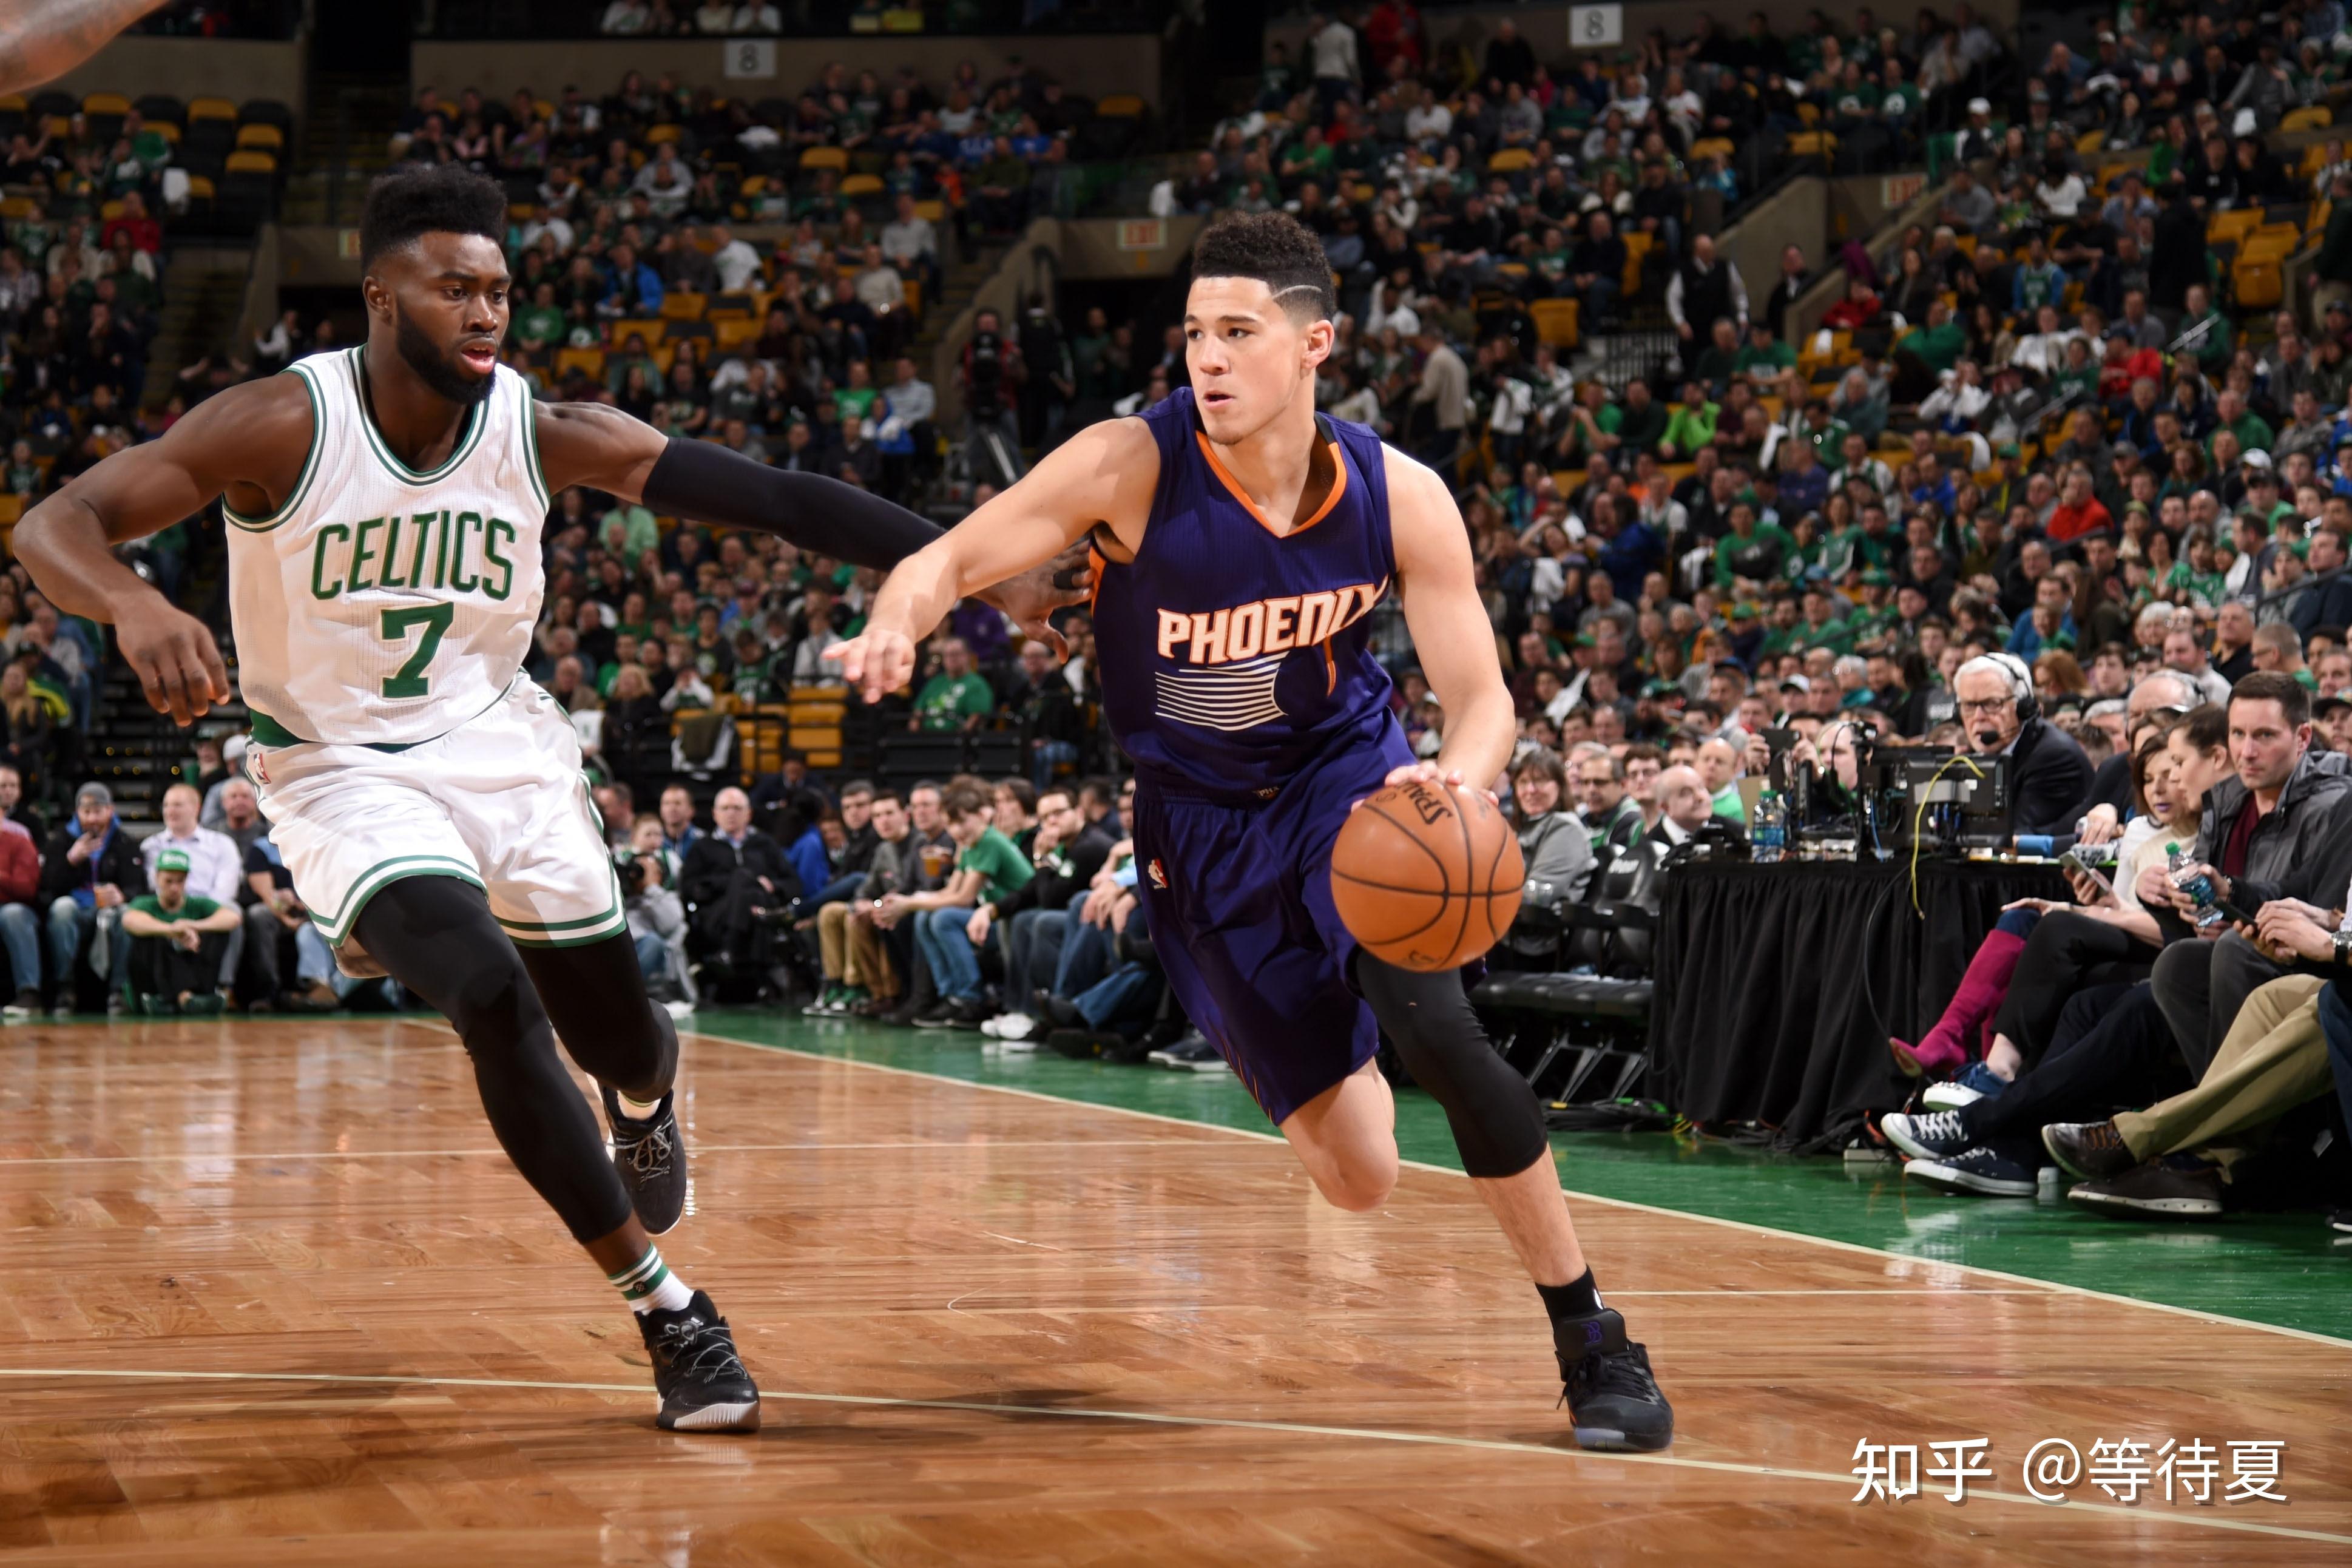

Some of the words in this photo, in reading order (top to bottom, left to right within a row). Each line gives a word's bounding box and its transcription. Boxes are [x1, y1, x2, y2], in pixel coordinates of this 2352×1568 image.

[739, 43, 759, 73] 8
[1584, 10, 1604, 41] 8
[311, 510, 516, 601] CELTICS
[380, 601, 455, 699] 7
[1157, 573, 1389, 664] PHOENIX
